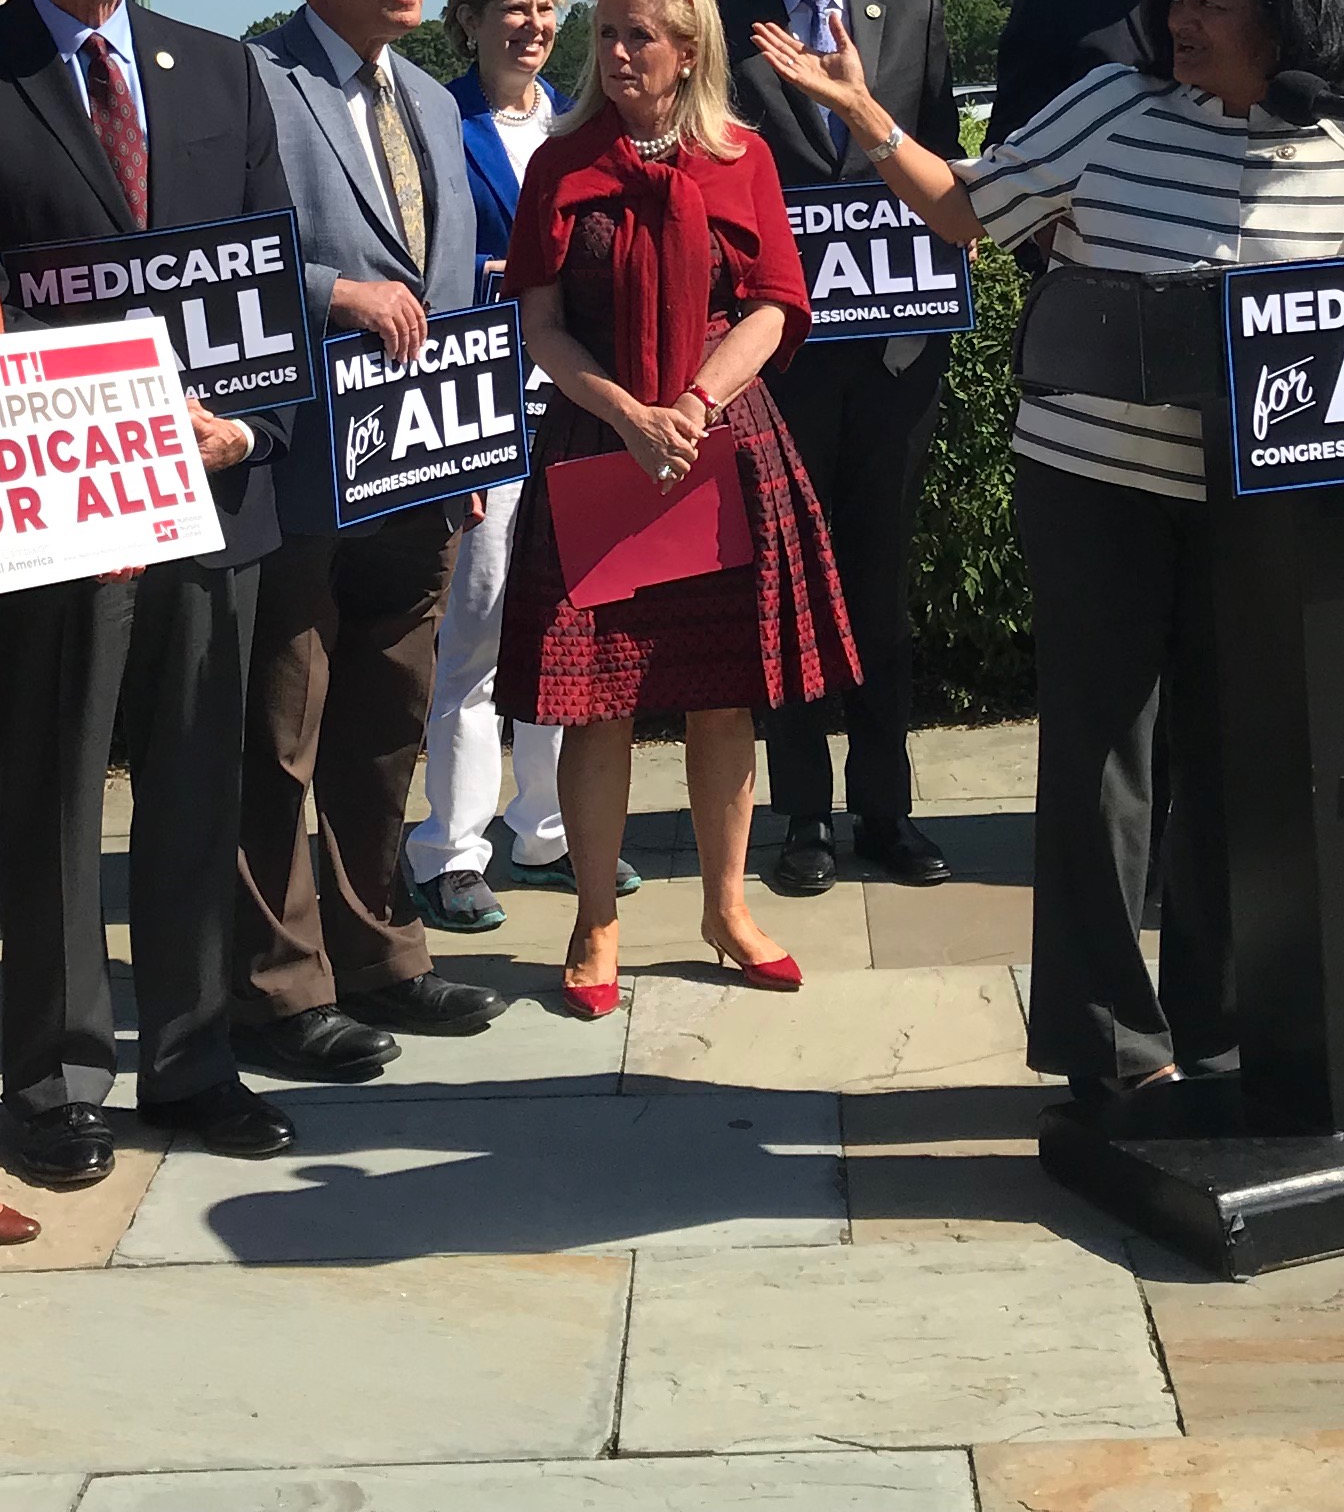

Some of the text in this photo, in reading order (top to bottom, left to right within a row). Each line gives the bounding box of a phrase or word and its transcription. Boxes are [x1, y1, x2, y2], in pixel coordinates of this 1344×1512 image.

[19, 235, 284, 308] MEDICARE
[811, 235, 956, 299] ALL
[125, 288, 294, 371] LL
[811, 300, 959, 324] ESSIONAL CAUCUS
[129, 375, 170, 410] IT!
[215, 366, 298, 395] CAUCUS
[1253, 364, 1313, 441] for
[346, 372, 515, 481] for ALL
[76, 460, 196, 523] ALL!
[345, 444, 518, 503] CONGRESSIONAL CAUCUS
[8, 556, 54, 572] America
